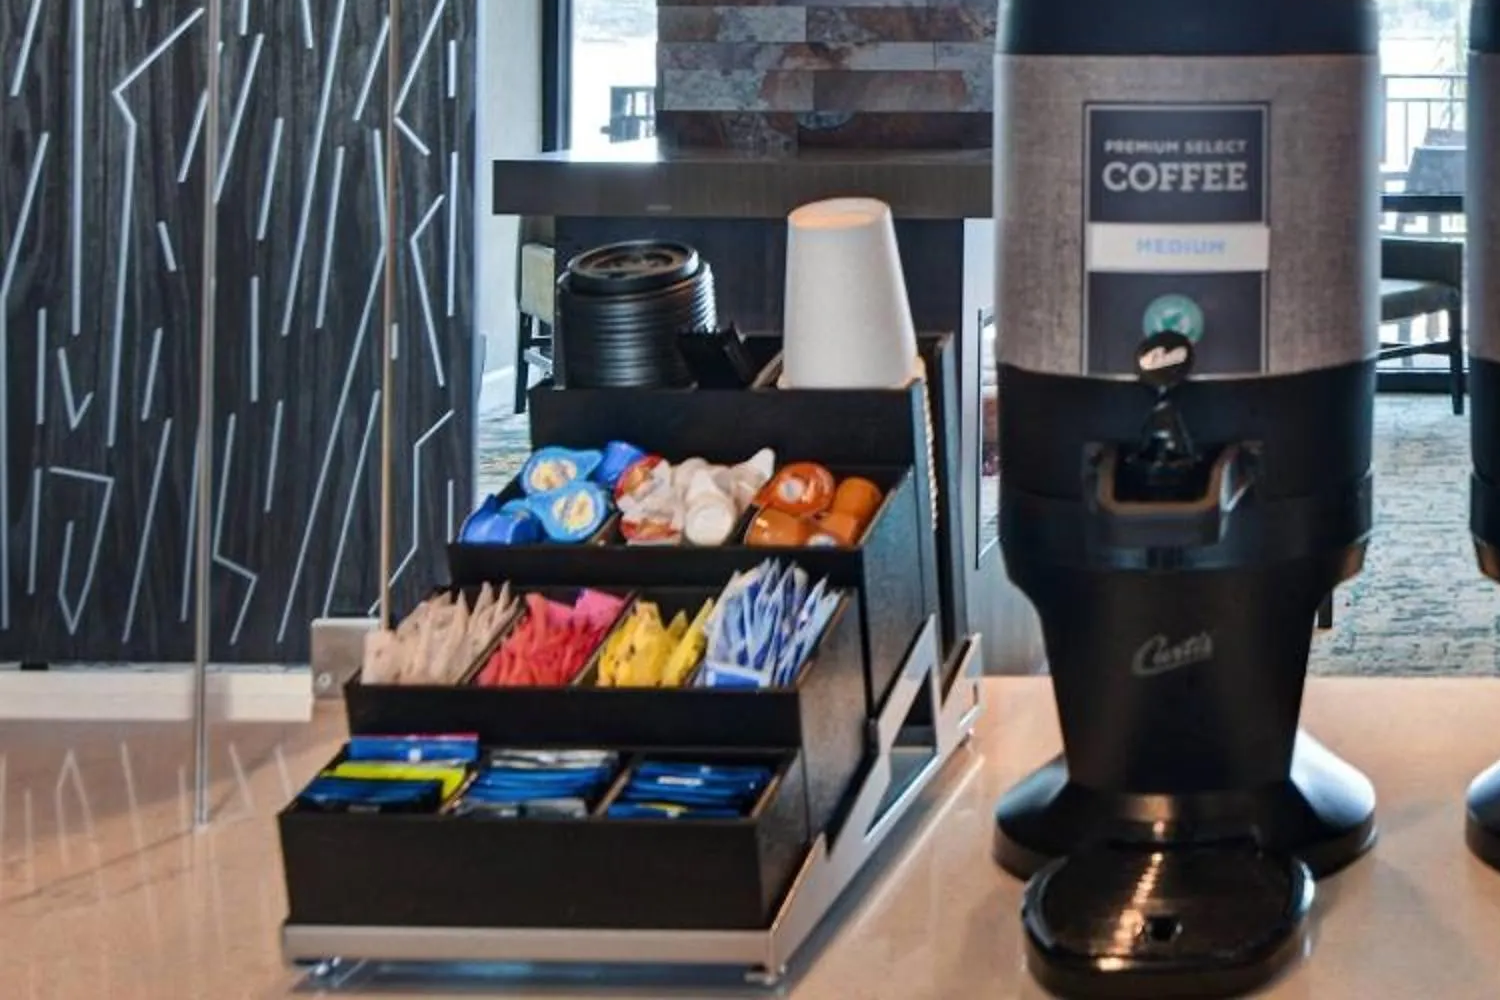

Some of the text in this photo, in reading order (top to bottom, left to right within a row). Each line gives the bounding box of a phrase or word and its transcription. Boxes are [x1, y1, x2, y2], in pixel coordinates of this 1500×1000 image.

[1104, 138, 1248, 154] PREMIUM SELECT
[1102, 160, 1248, 192] COFFEE
[1136, 237, 1226, 255] MEDIUM
